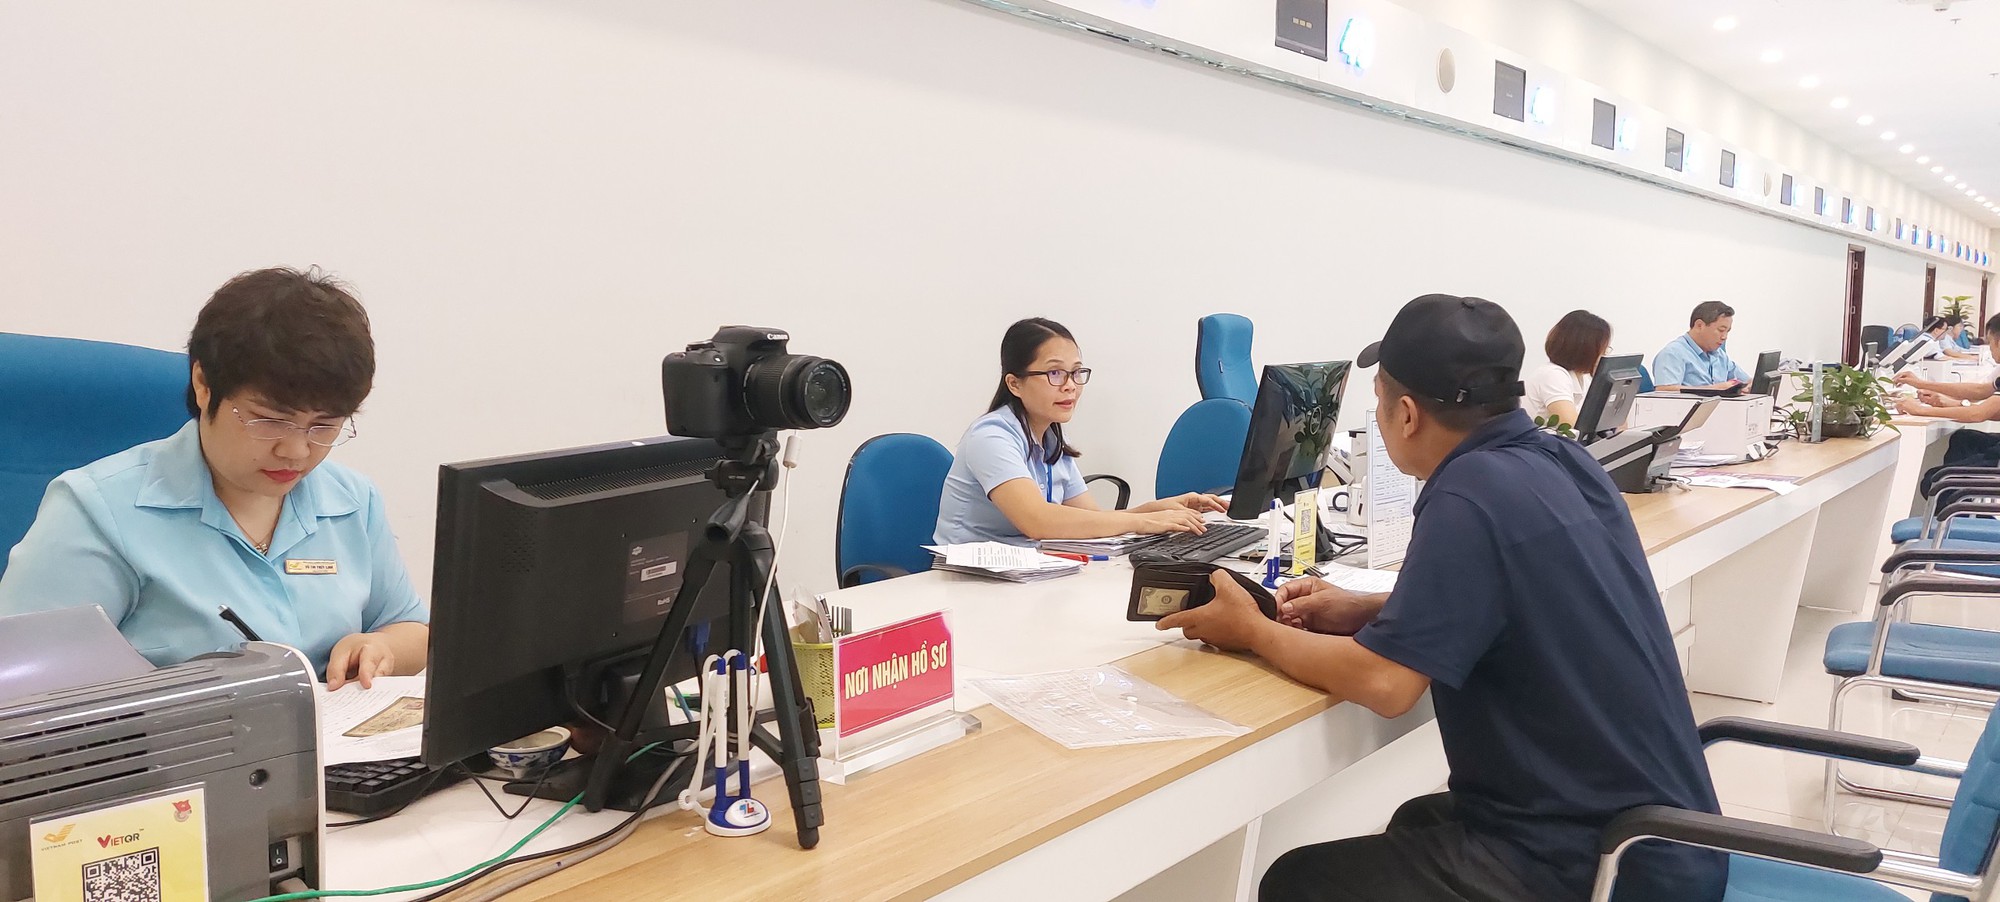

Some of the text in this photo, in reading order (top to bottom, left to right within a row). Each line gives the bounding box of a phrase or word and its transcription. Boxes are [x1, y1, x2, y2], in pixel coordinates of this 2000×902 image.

[844, 640, 948, 700] NƠI NHẬN HỒ SƠ
[41, 843, 66, 851] VIETNAM
